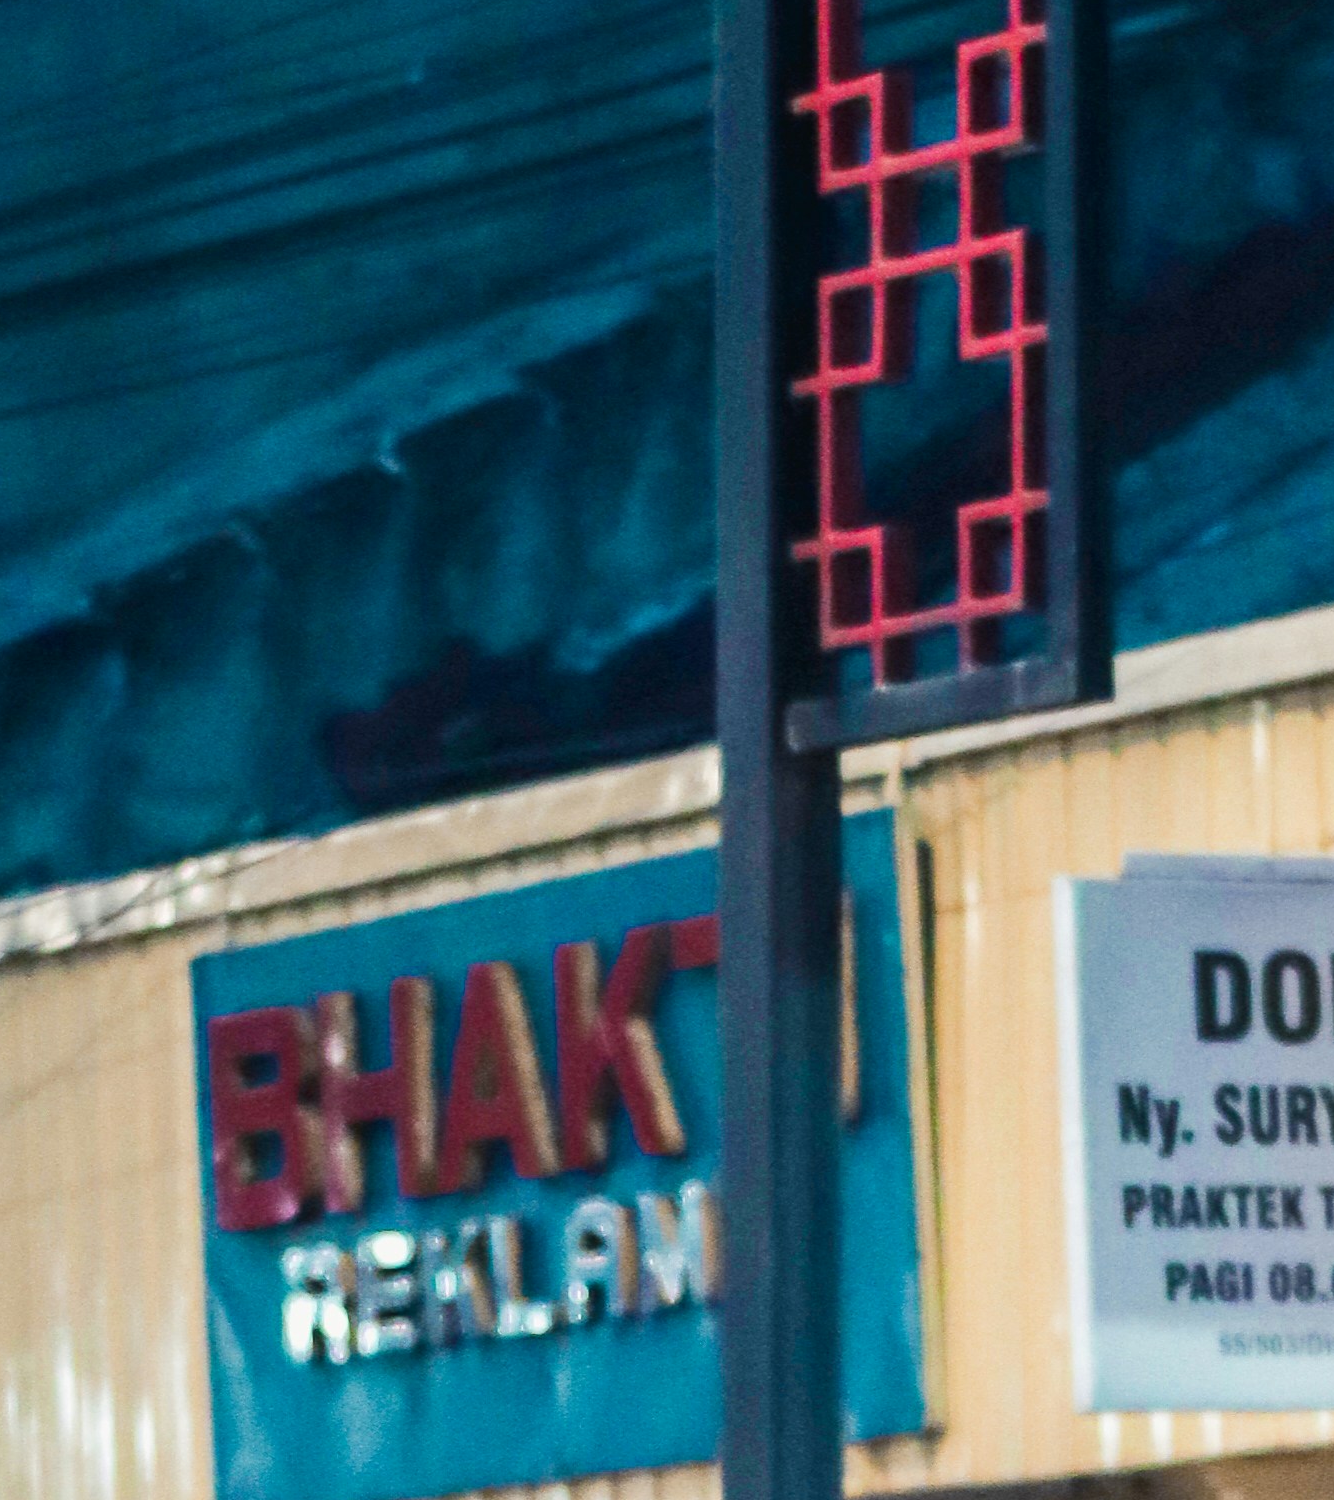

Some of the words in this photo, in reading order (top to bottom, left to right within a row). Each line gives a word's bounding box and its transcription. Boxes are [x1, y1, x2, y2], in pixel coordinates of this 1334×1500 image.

[207, 890, 861, 1232] BHAK
[1117, 1082, 1195, 1158] Ny.
[1121, 1184, 1305, 1230] PRAKTEK
[1165, 1261, 1255, 1303] PAGI
